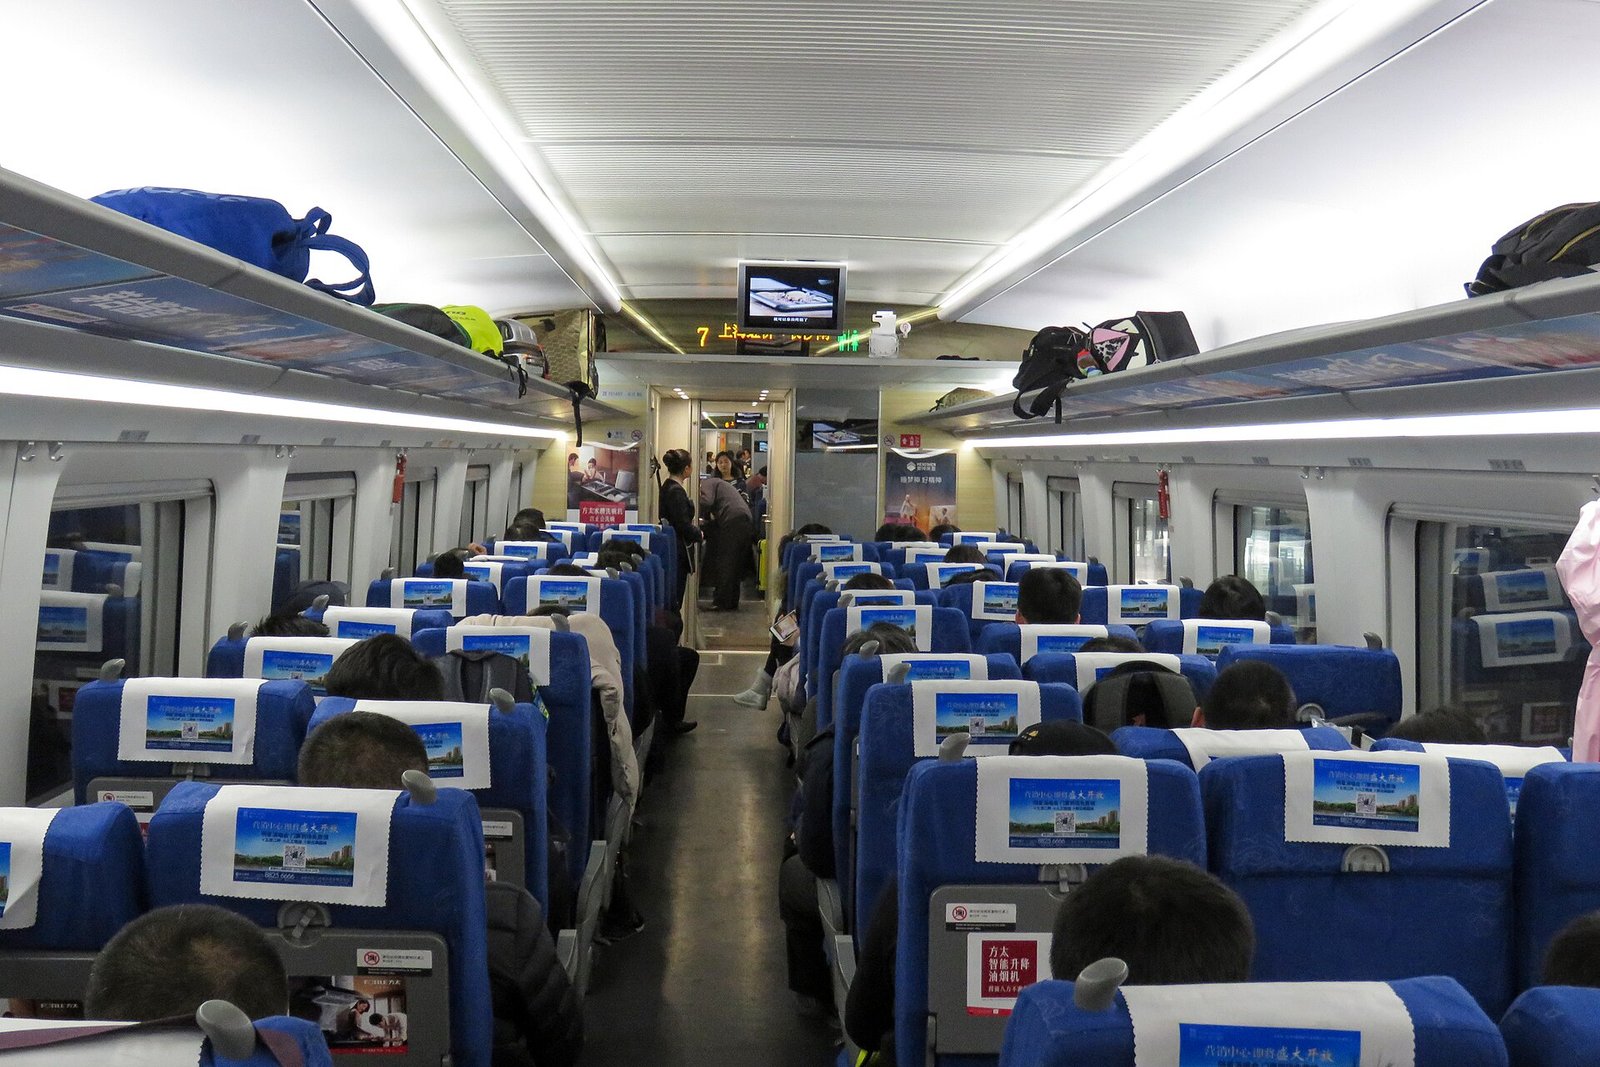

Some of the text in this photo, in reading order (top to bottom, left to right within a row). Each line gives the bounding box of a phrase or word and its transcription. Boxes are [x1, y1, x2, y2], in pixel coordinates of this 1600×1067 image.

[697, 327, 710, 347] 7
[988, 945, 1009, 958] 方太
[988, 958, 1030, 970] 智能升降
[988, 971, 1020, 982] 油烟机
